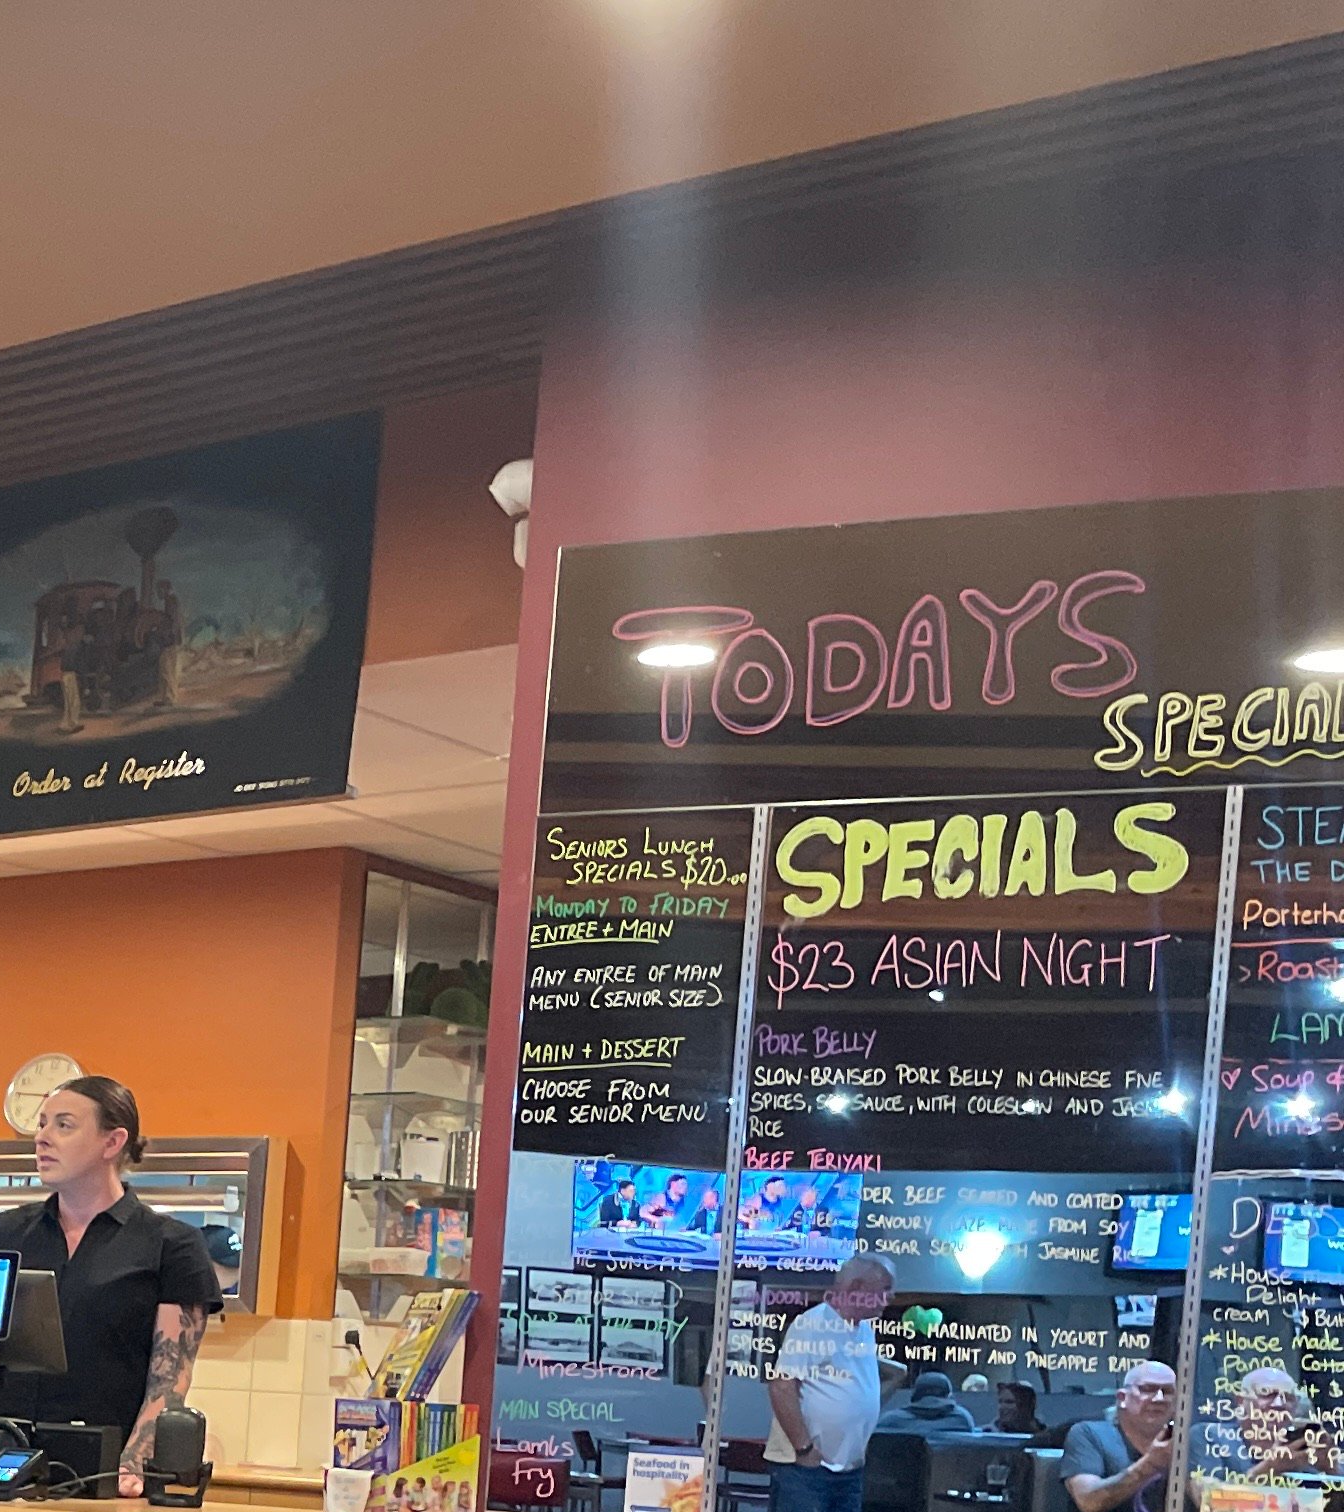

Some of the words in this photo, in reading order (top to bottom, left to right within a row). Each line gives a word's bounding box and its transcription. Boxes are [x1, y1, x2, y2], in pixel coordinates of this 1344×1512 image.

[613, 569, 1146, 749] TODAYS
[13, 768, 72, 798] Order
[83, 761, 109, 789] at
[119, 750, 207, 791] Register
[547, 827, 628, 861] SENIORS
[644, 827, 714, 856] LUNCH
[566, 860, 677, 885] SPECIALS
[775, 802, 1191, 920] SPECIALS
[1250, 859, 1312, 884] THE
[536, 895, 610, 918] MONDAY
[619, 896, 637, 914] TO
[650, 892, 729, 919] FRIDAY
[530, 921, 598, 943] ENTREE
[618, 919, 674, 939] MAIN
[530, 966, 566, 989] ANY
[573, 964, 637, 985] ENTREE
[648, 964, 672, 983] OF
[674, 964, 723, 983] MAIN
[767, 934, 857, 1010] $23
[871, 932, 1002, 991] ASIAN
[1019, 933, 1171, 992] NIGHT
[529, 992, 580, 1012] MENU
[522, 1041, 574, 1065] MAIN
[600, 1037, 686, 1061] DESSERT
[755, 1023, 808, 1057] PORK
[812, 1026, 877, 1060] BELLY
[754, 1065, 887, 1087] SLOW-BRAISED
[895, 1063, 942, 1086] PORK
[948, 1066, 1004, 1089] BELLY
[1016, 1070, 1033, 1088] IN
[1039, 1070, 1111, 1089] CHINESE
[522, 1078, 592, 1101] CHOOSE
[607, 1078, 671, 1102] FROM
[520, 1105, 558, 1124] OUR
[568, 1103, 635, 1124] SENIOR
[917, 1096, 956, 1114] WITH
[968, 1095, 1053, 1116] COLESLW
[1065, 1097, 1104, 1116] AND
[749, 1117, 785, 1139] RICE
[744, 1146, 795, 1171] BEEF
[807, 1148, 882, 1174] TERIYAKI
[903, 1185, 946, 1205] BEEF
[1027, 1190, 1059, 1208] AND
[1066, 1192, 1124, 1210] COATED
[866, 1213, 933, 1235] SAVOURY
[1049, 1217, 1087, 1235] FROM
[1098, 1220, 1130, 1240] SOY
[875, 1239, 920, 1256] SUGAR
[732, 1313, 786, 1331] SMOKEY
[927, 1321, 1012, 1343] MARINATED
[1022, 1326, 1038, 1343] IN
[1050, 1327, 1108, 1348] YOGURT
[1118, 1331, 1150, 1349] AND
[727, 1361, 758, 1379] AND
[905, 1345, 936, 1362] WITH
[945, 1347, 981, 1365] MINT
[988, 1349, 1016, 1366] AND
[1026, 1351, 1098, 1373] PINEAPPLE
[499, 1400, 539, 1420] MAIN
[546, 1398, 624, 1423] SPECIAL
[632, 1468, 689, 1482] hospitality
[633, 1457, 676, 1470] Seafood
[679, 1461, 690, 1470] in
